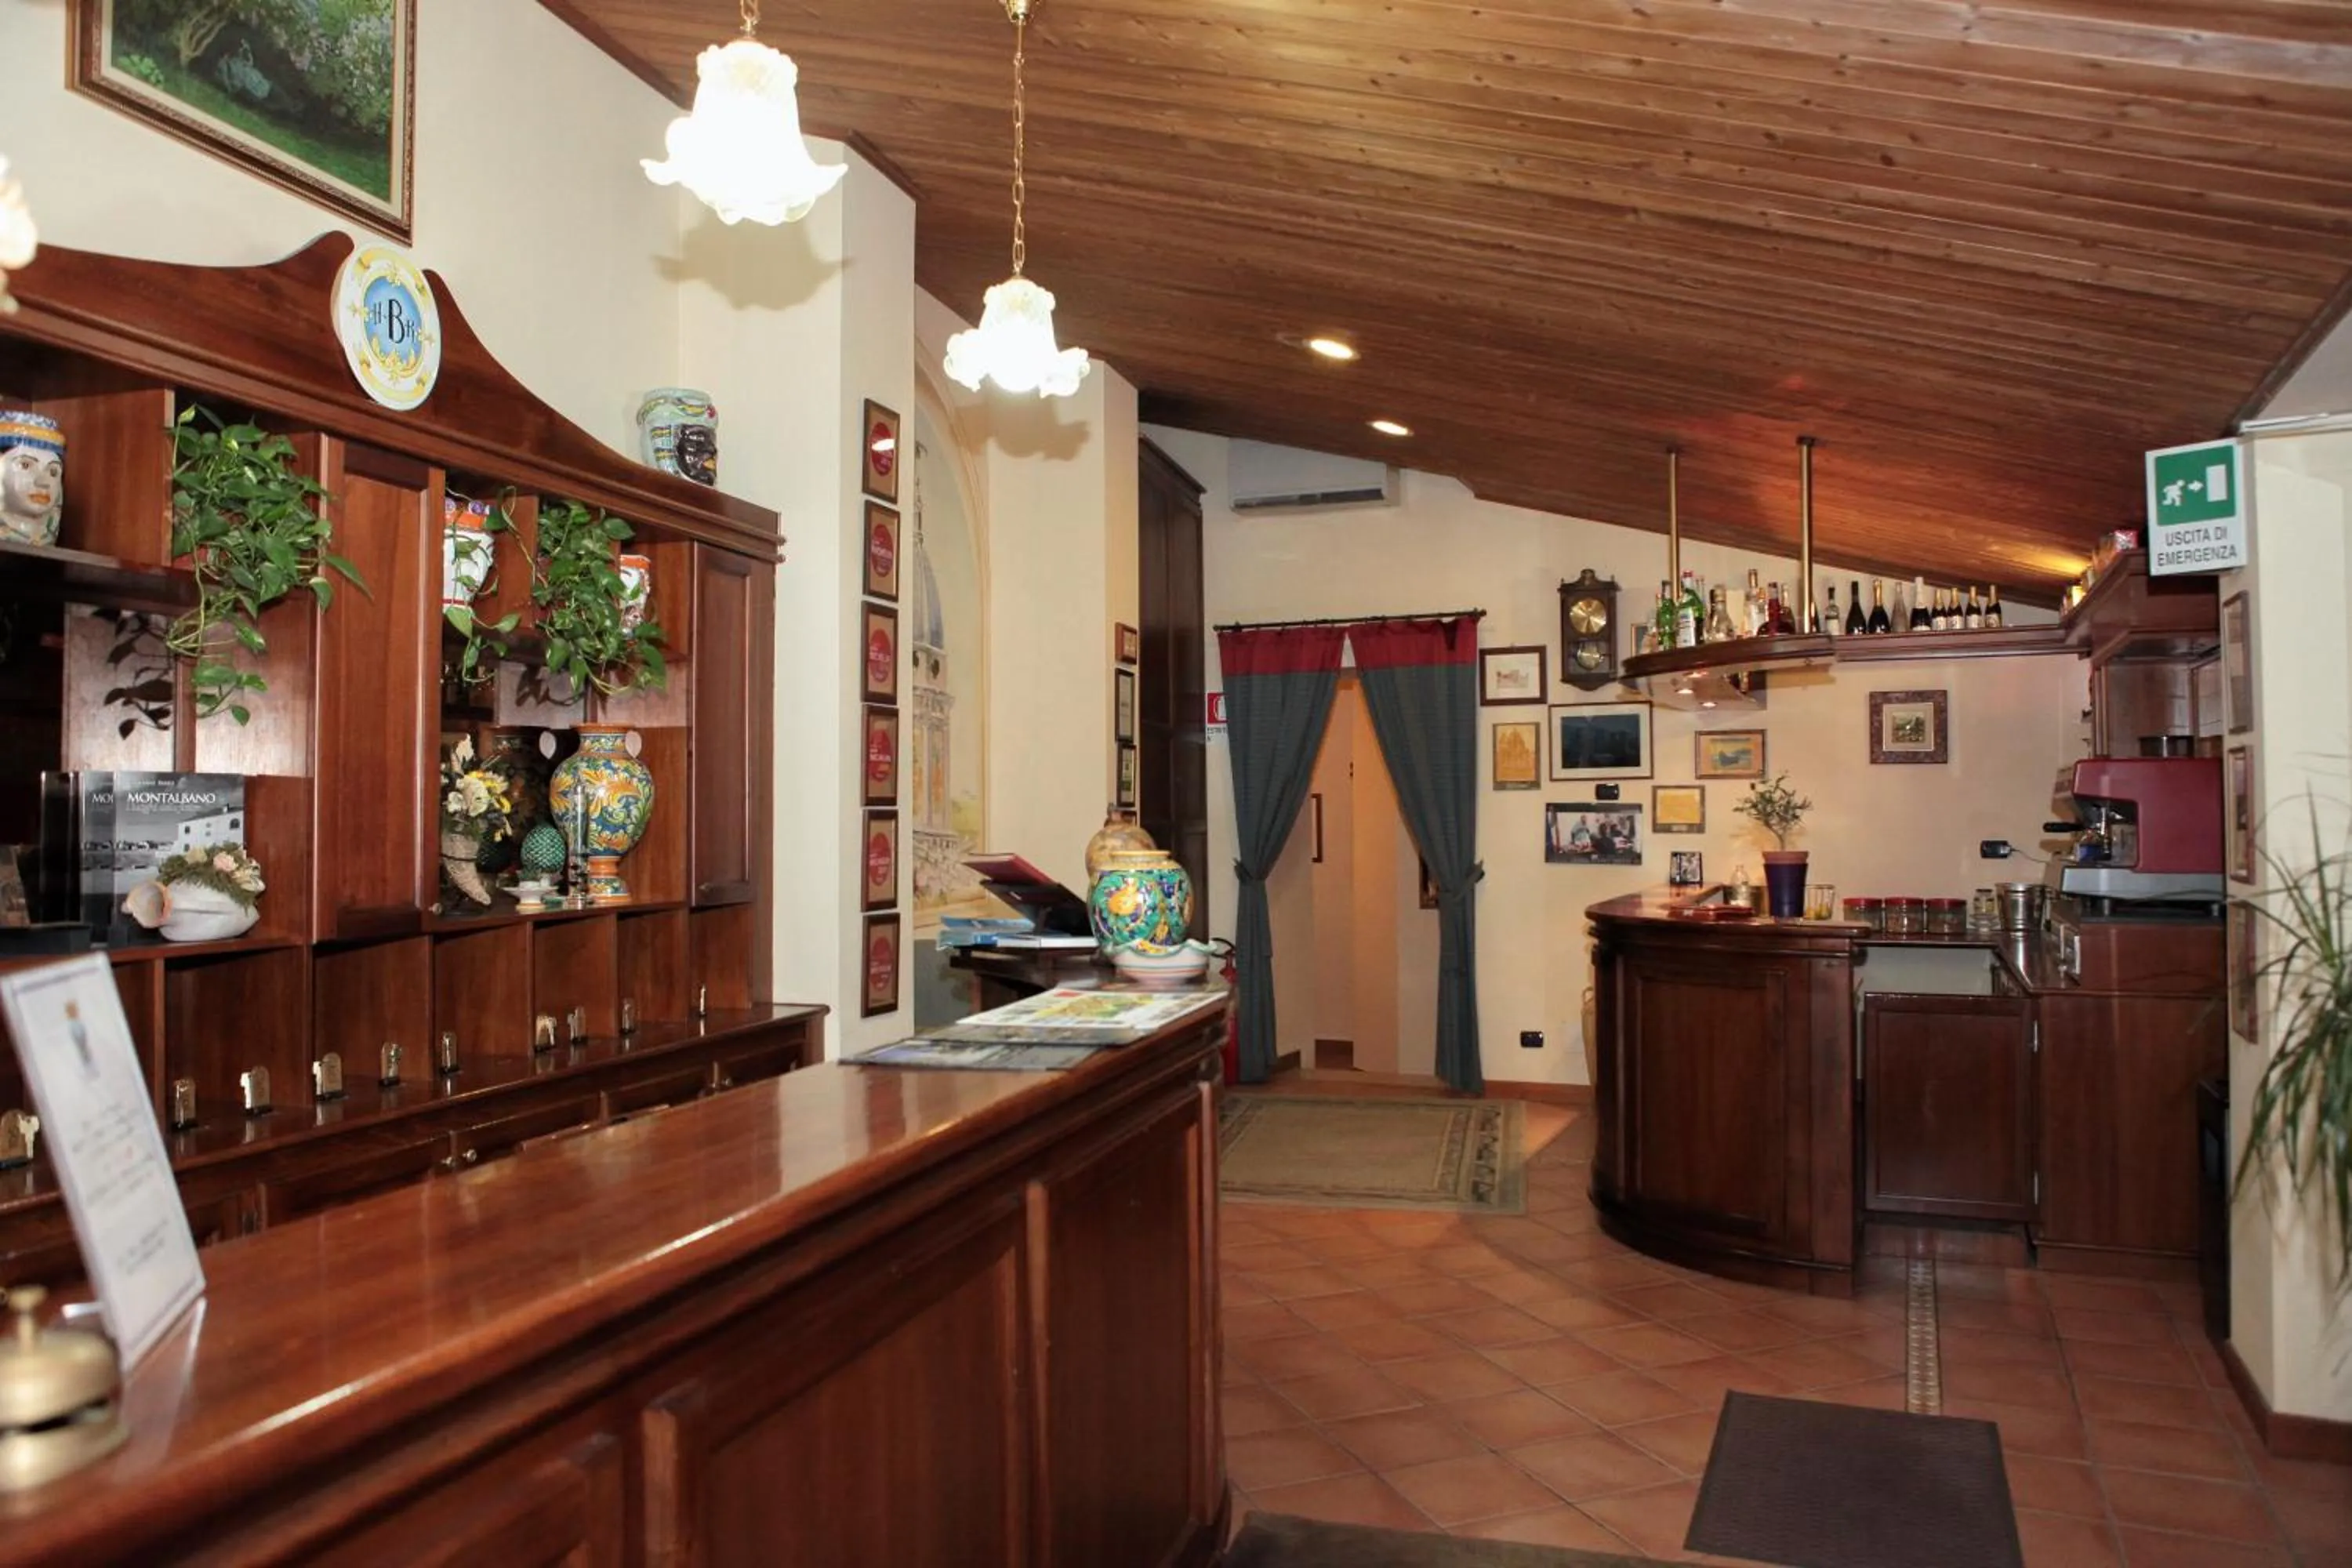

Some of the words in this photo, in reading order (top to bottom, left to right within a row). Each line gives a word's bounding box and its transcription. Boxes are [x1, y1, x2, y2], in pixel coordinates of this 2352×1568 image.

[2165, 528, 2210, 546] USCITA
[2214, 526, 2228, 540] DI
[2157, 544, 2238, 566] EMERGENZA
[127, 792, 216, 804] MONTALBANO
